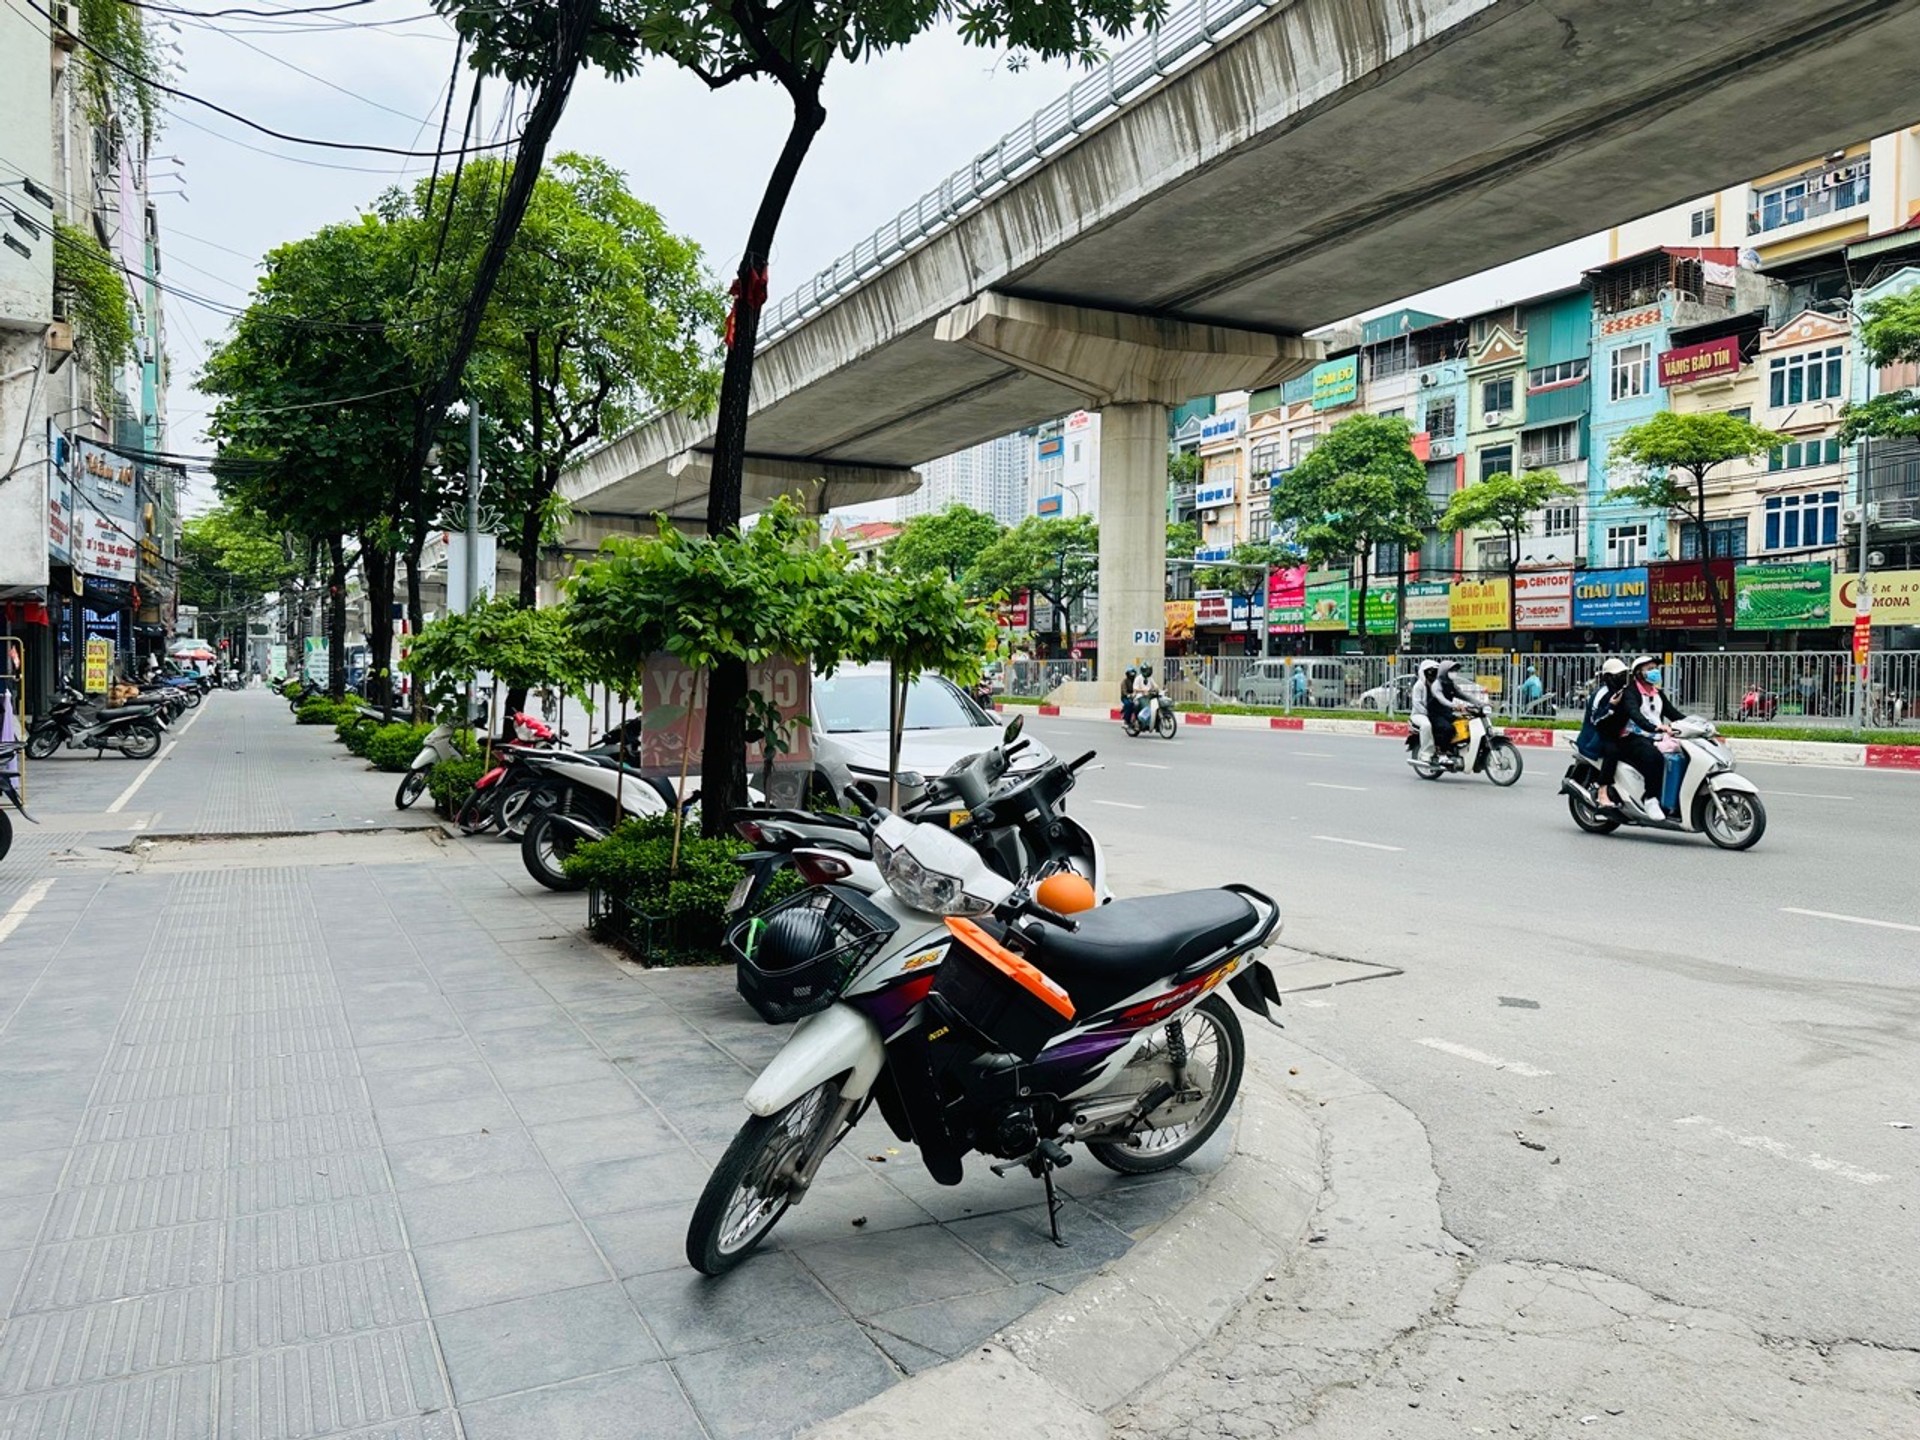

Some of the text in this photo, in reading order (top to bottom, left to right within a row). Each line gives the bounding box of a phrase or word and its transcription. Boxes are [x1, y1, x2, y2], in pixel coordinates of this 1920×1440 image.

[1664, 347, 1730, 377] VÀNG BẢO TÍN
[1529, 576, 1569, 587] CENTOSY
[1615, 581, 1644, 597] LINH
[1872, 597, 1910, 608] MONA
